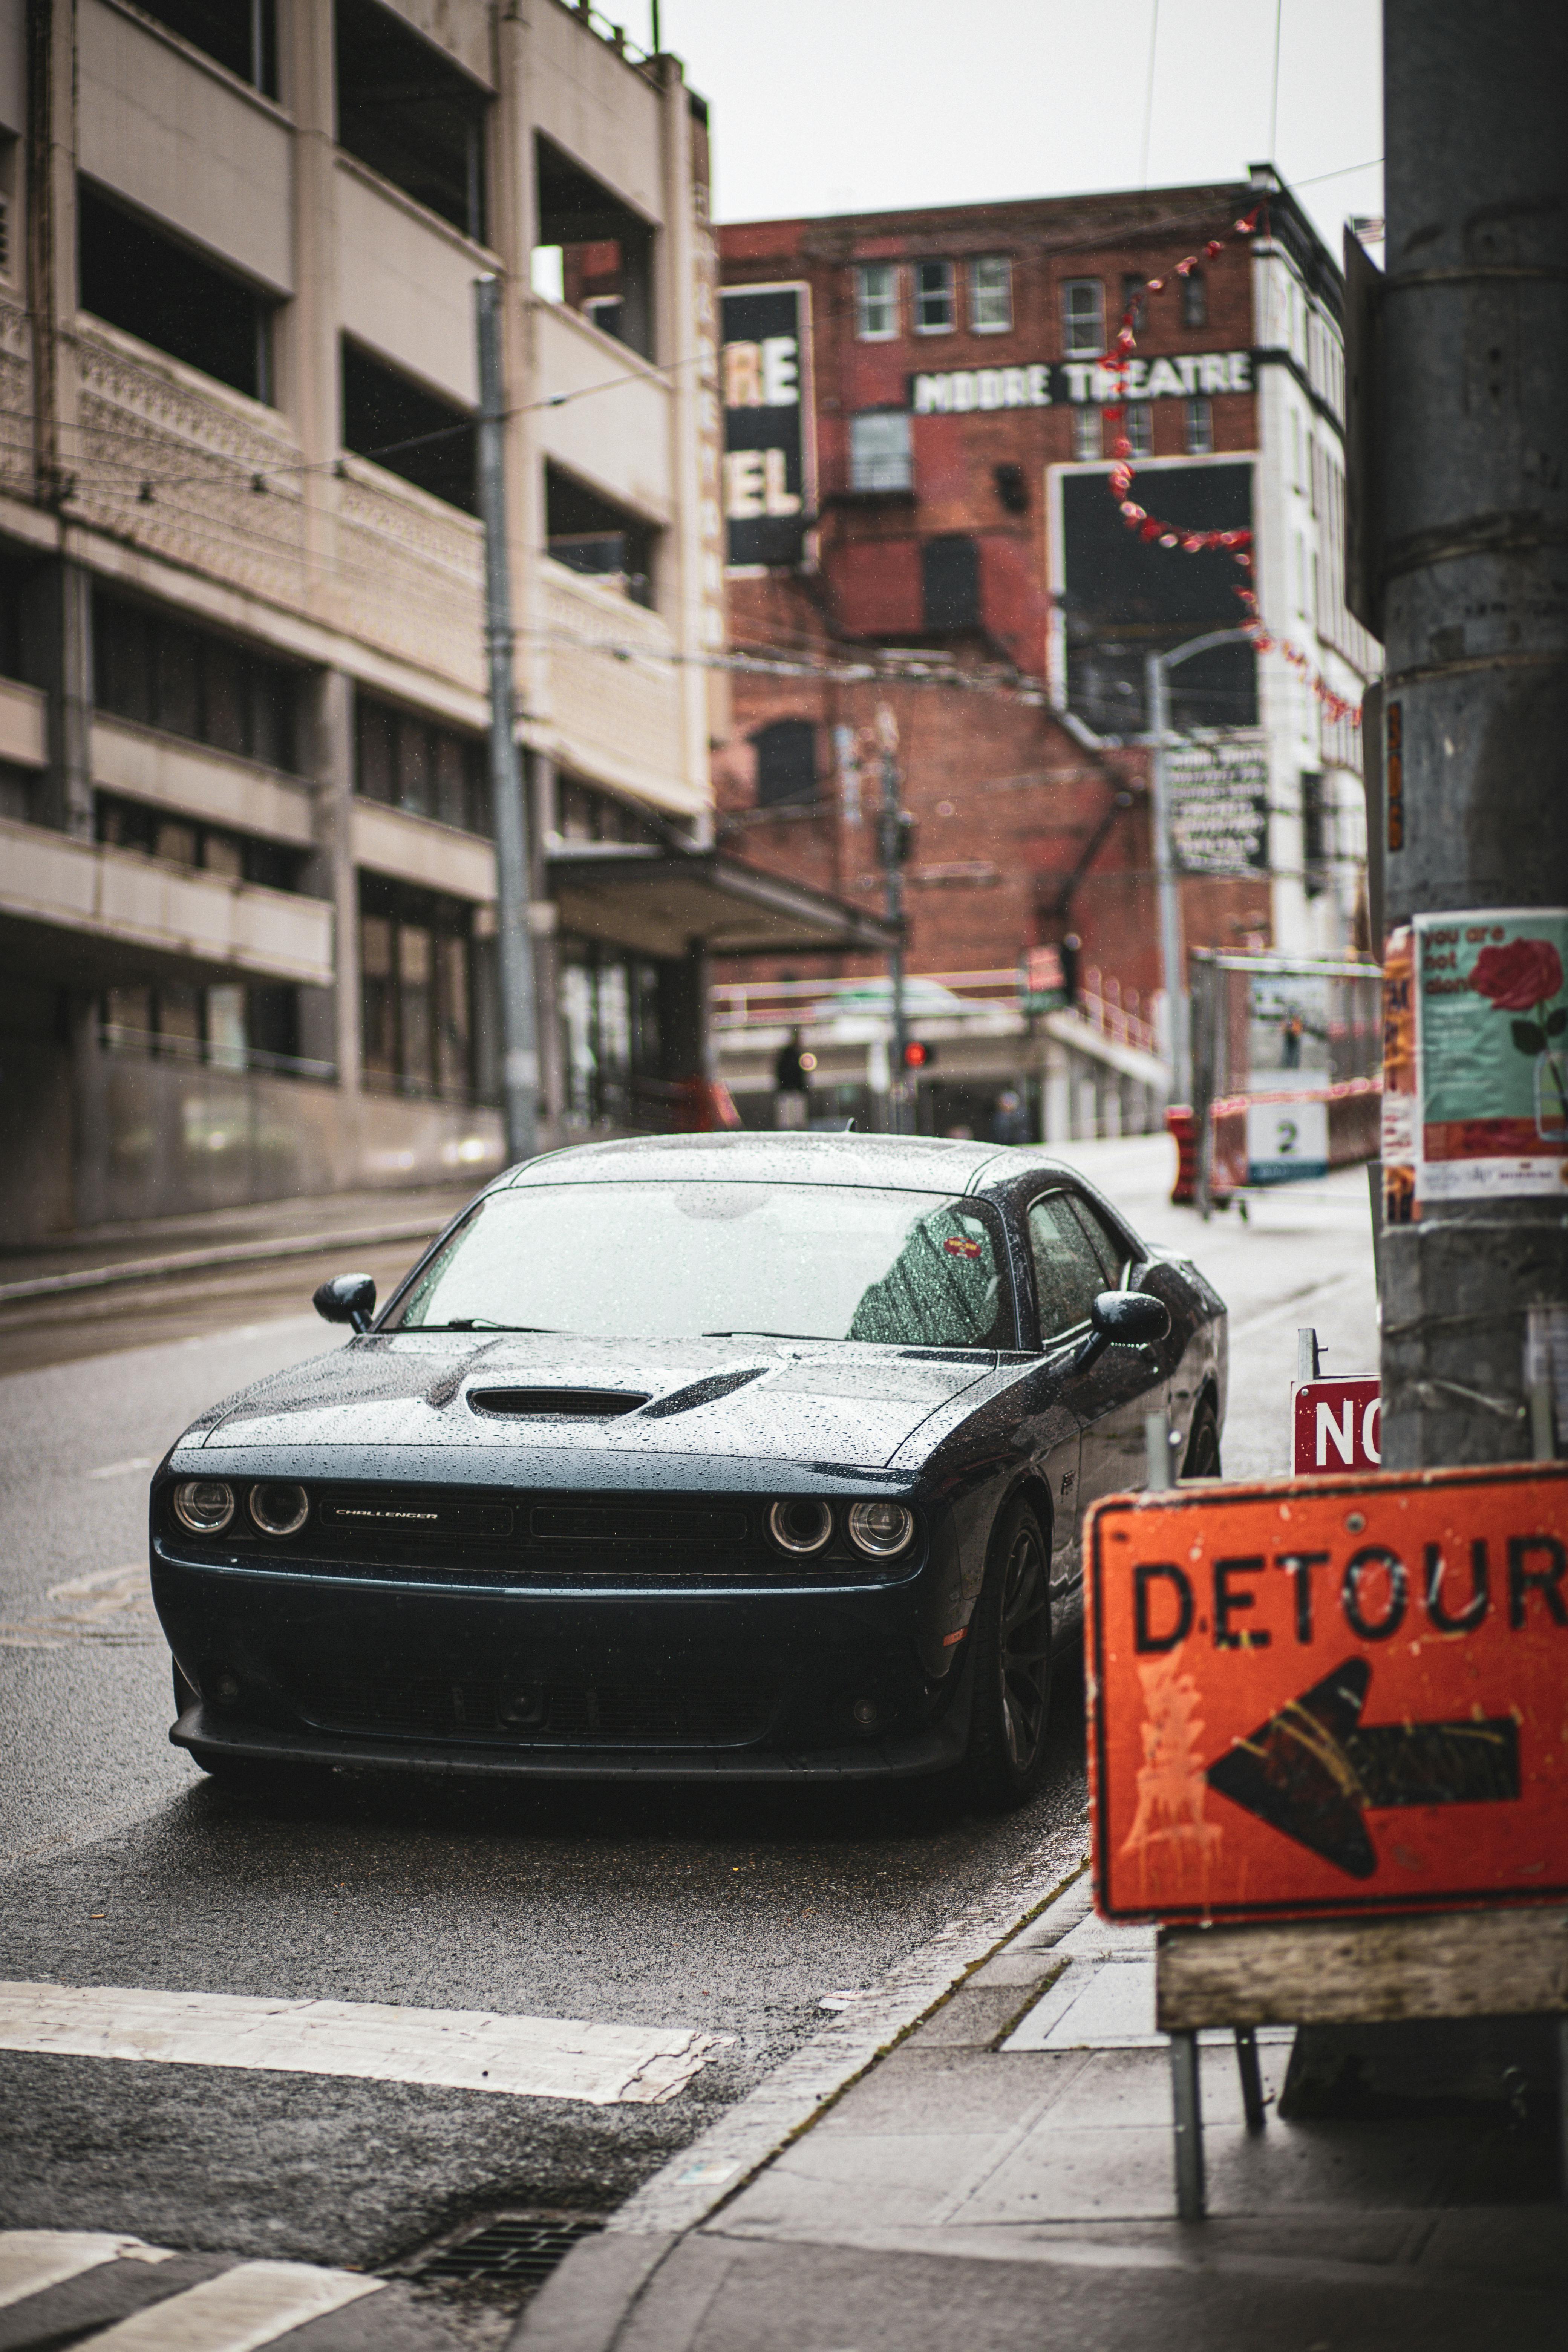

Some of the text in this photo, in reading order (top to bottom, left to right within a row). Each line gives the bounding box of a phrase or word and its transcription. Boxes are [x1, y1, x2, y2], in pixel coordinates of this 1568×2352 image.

[913, 351, 1251, 415] MOORE THEATRE
[1465, 925, 1505, 943] are
[1276, 1118, 1298, 1154] 2
[336, 1509, 438, 1519] CHALLENGER
[1133, 1534, 1568, 1655] DETOUR
